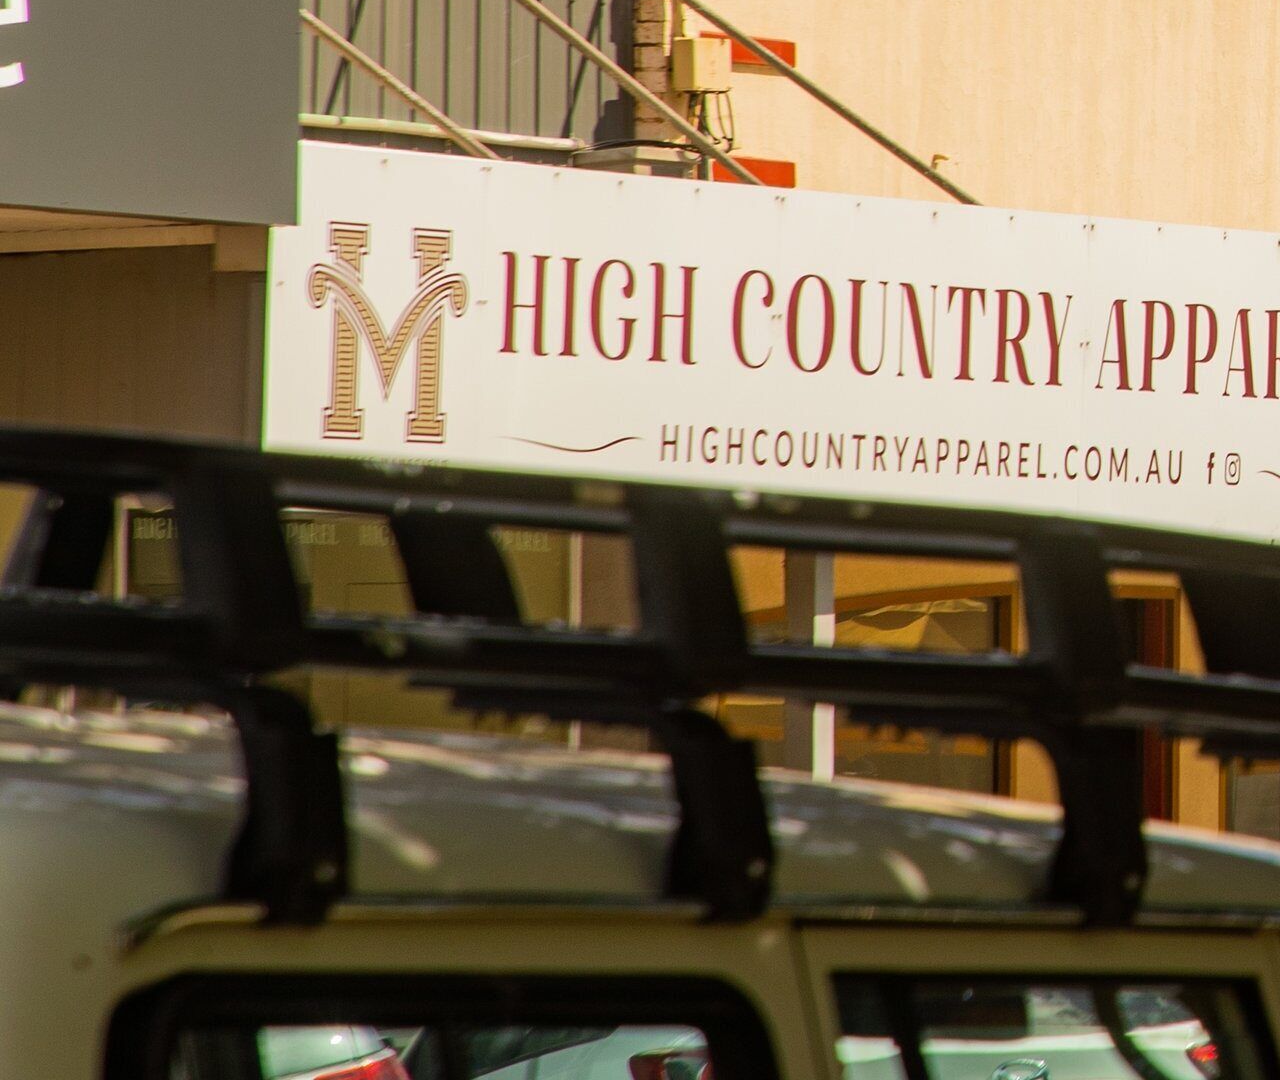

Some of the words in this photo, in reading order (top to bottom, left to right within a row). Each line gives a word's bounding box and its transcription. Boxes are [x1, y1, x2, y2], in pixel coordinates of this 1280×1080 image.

[500, 250, 699, 366] HIGH
[731, 269, 1074, 388] COUNTRY
[661, 422, 1184, 484] HIGHCOUNTRYAPPAREL.COM.AU
